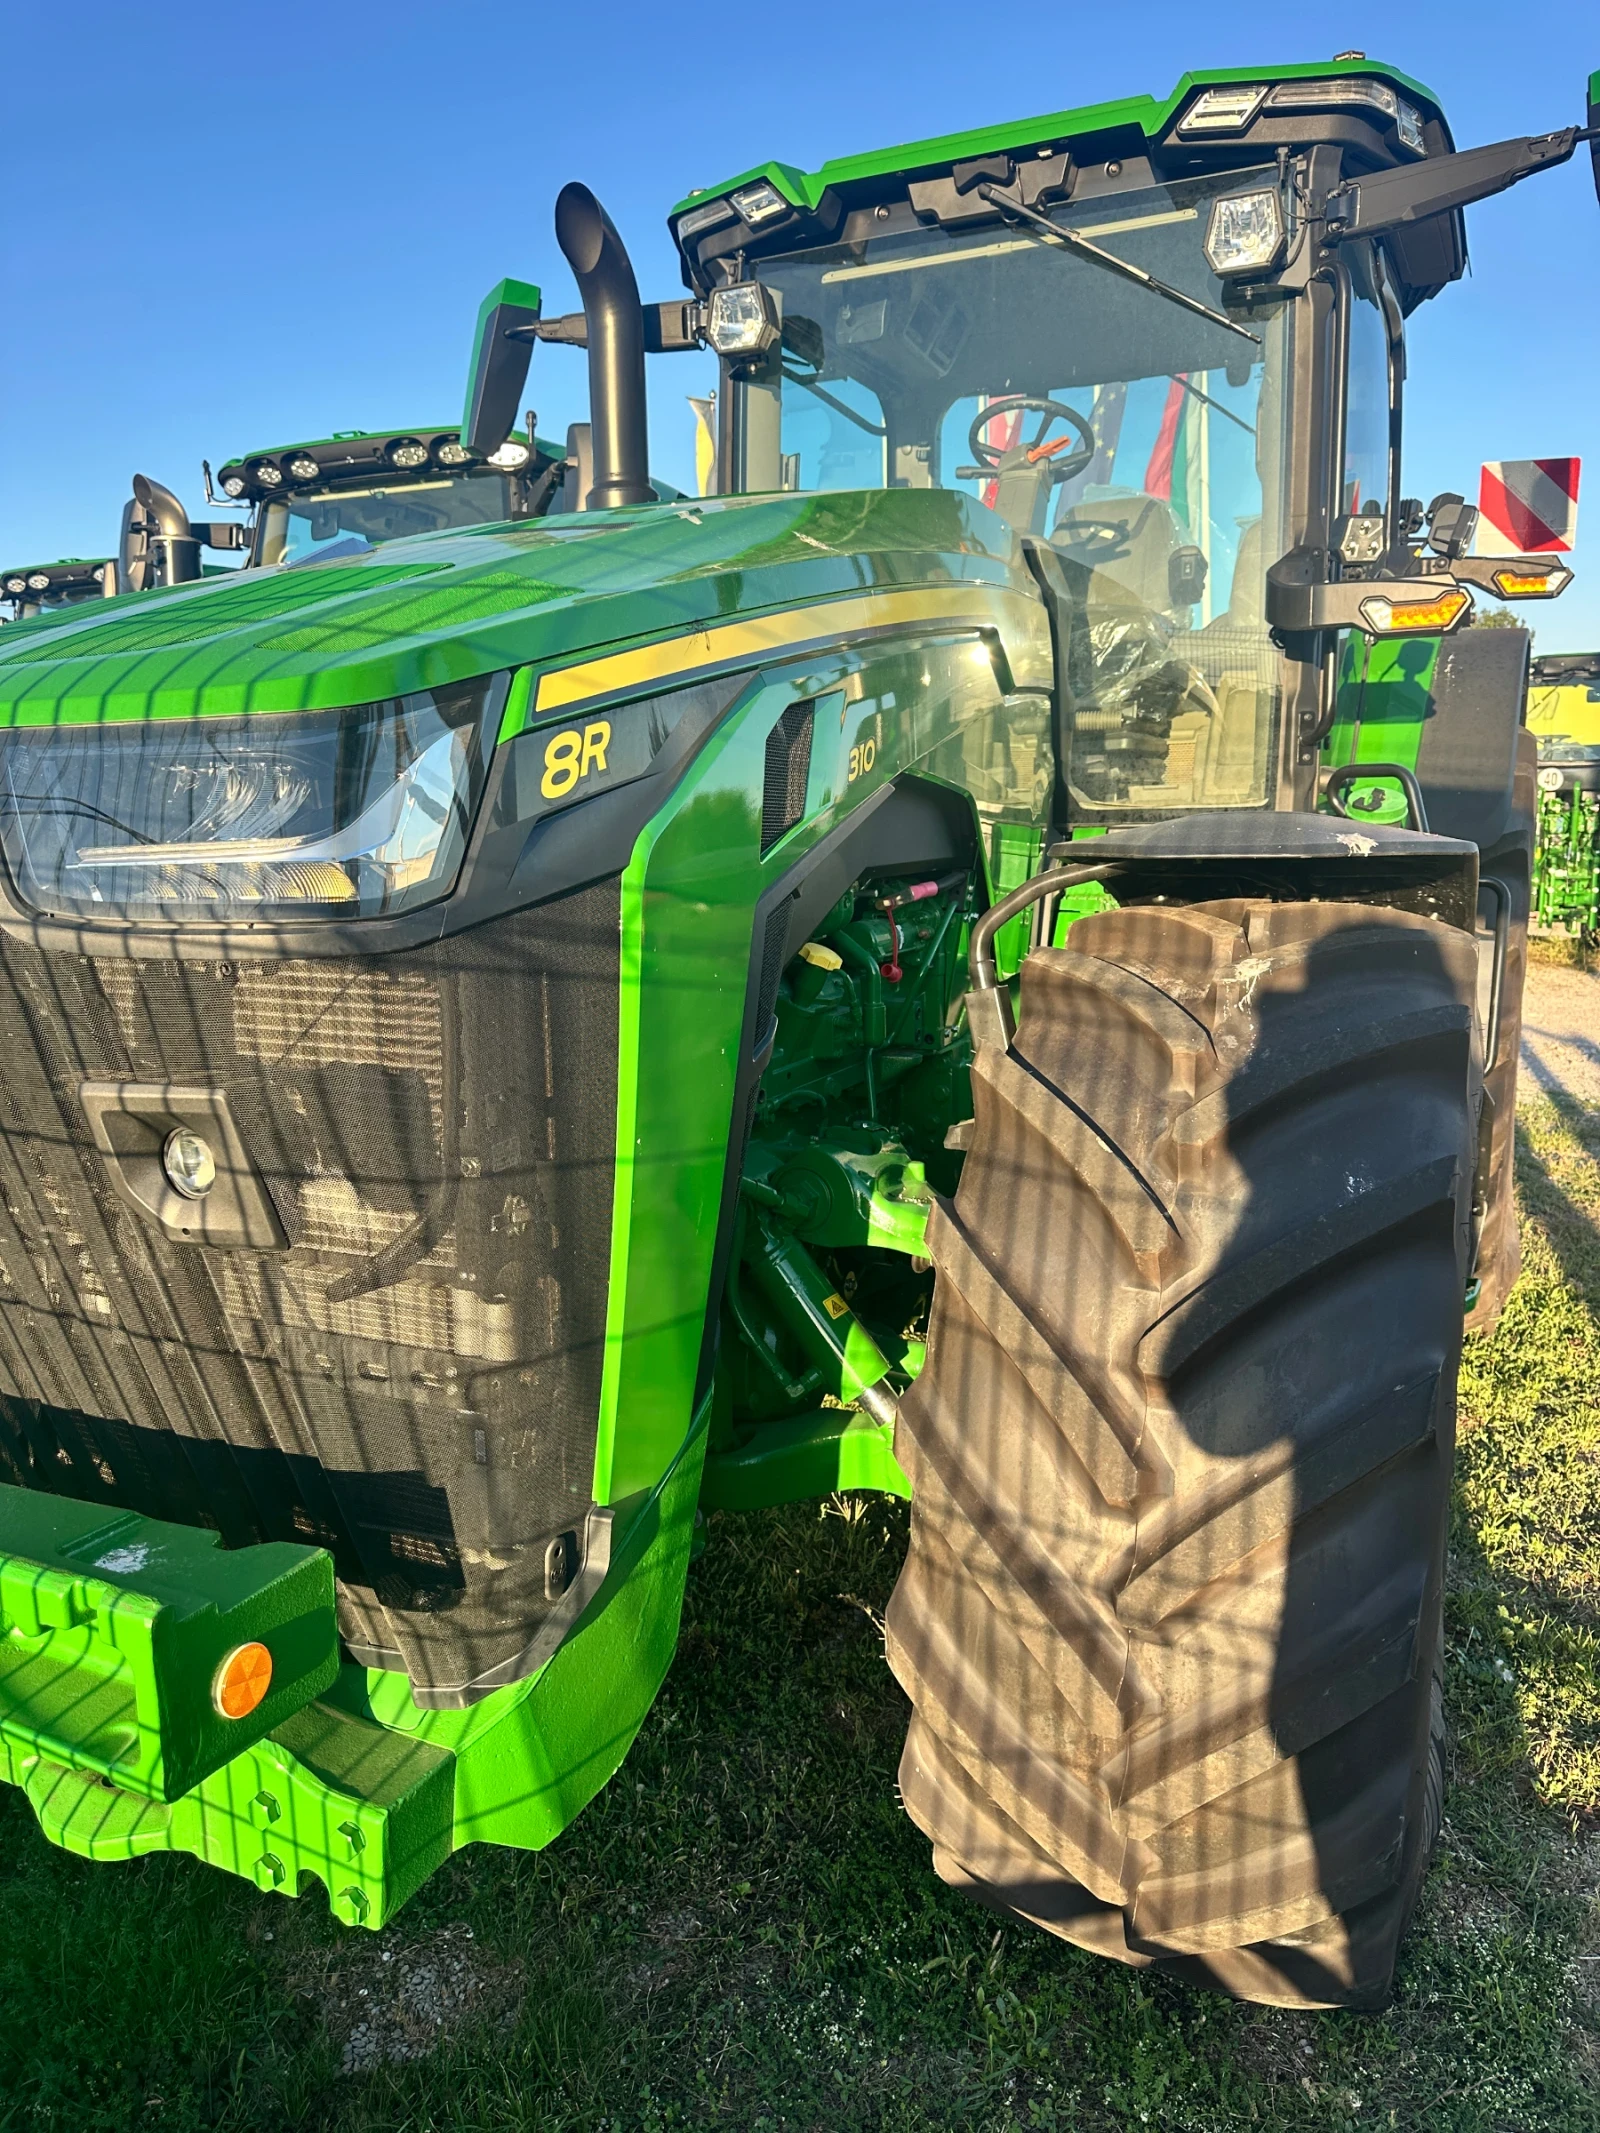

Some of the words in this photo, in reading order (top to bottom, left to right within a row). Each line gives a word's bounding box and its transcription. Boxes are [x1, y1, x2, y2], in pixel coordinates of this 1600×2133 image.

[541, 721, 611, 799] 8R
[848, 738, 876, 782] 310
[1544, 772, 1558, 786] 40
